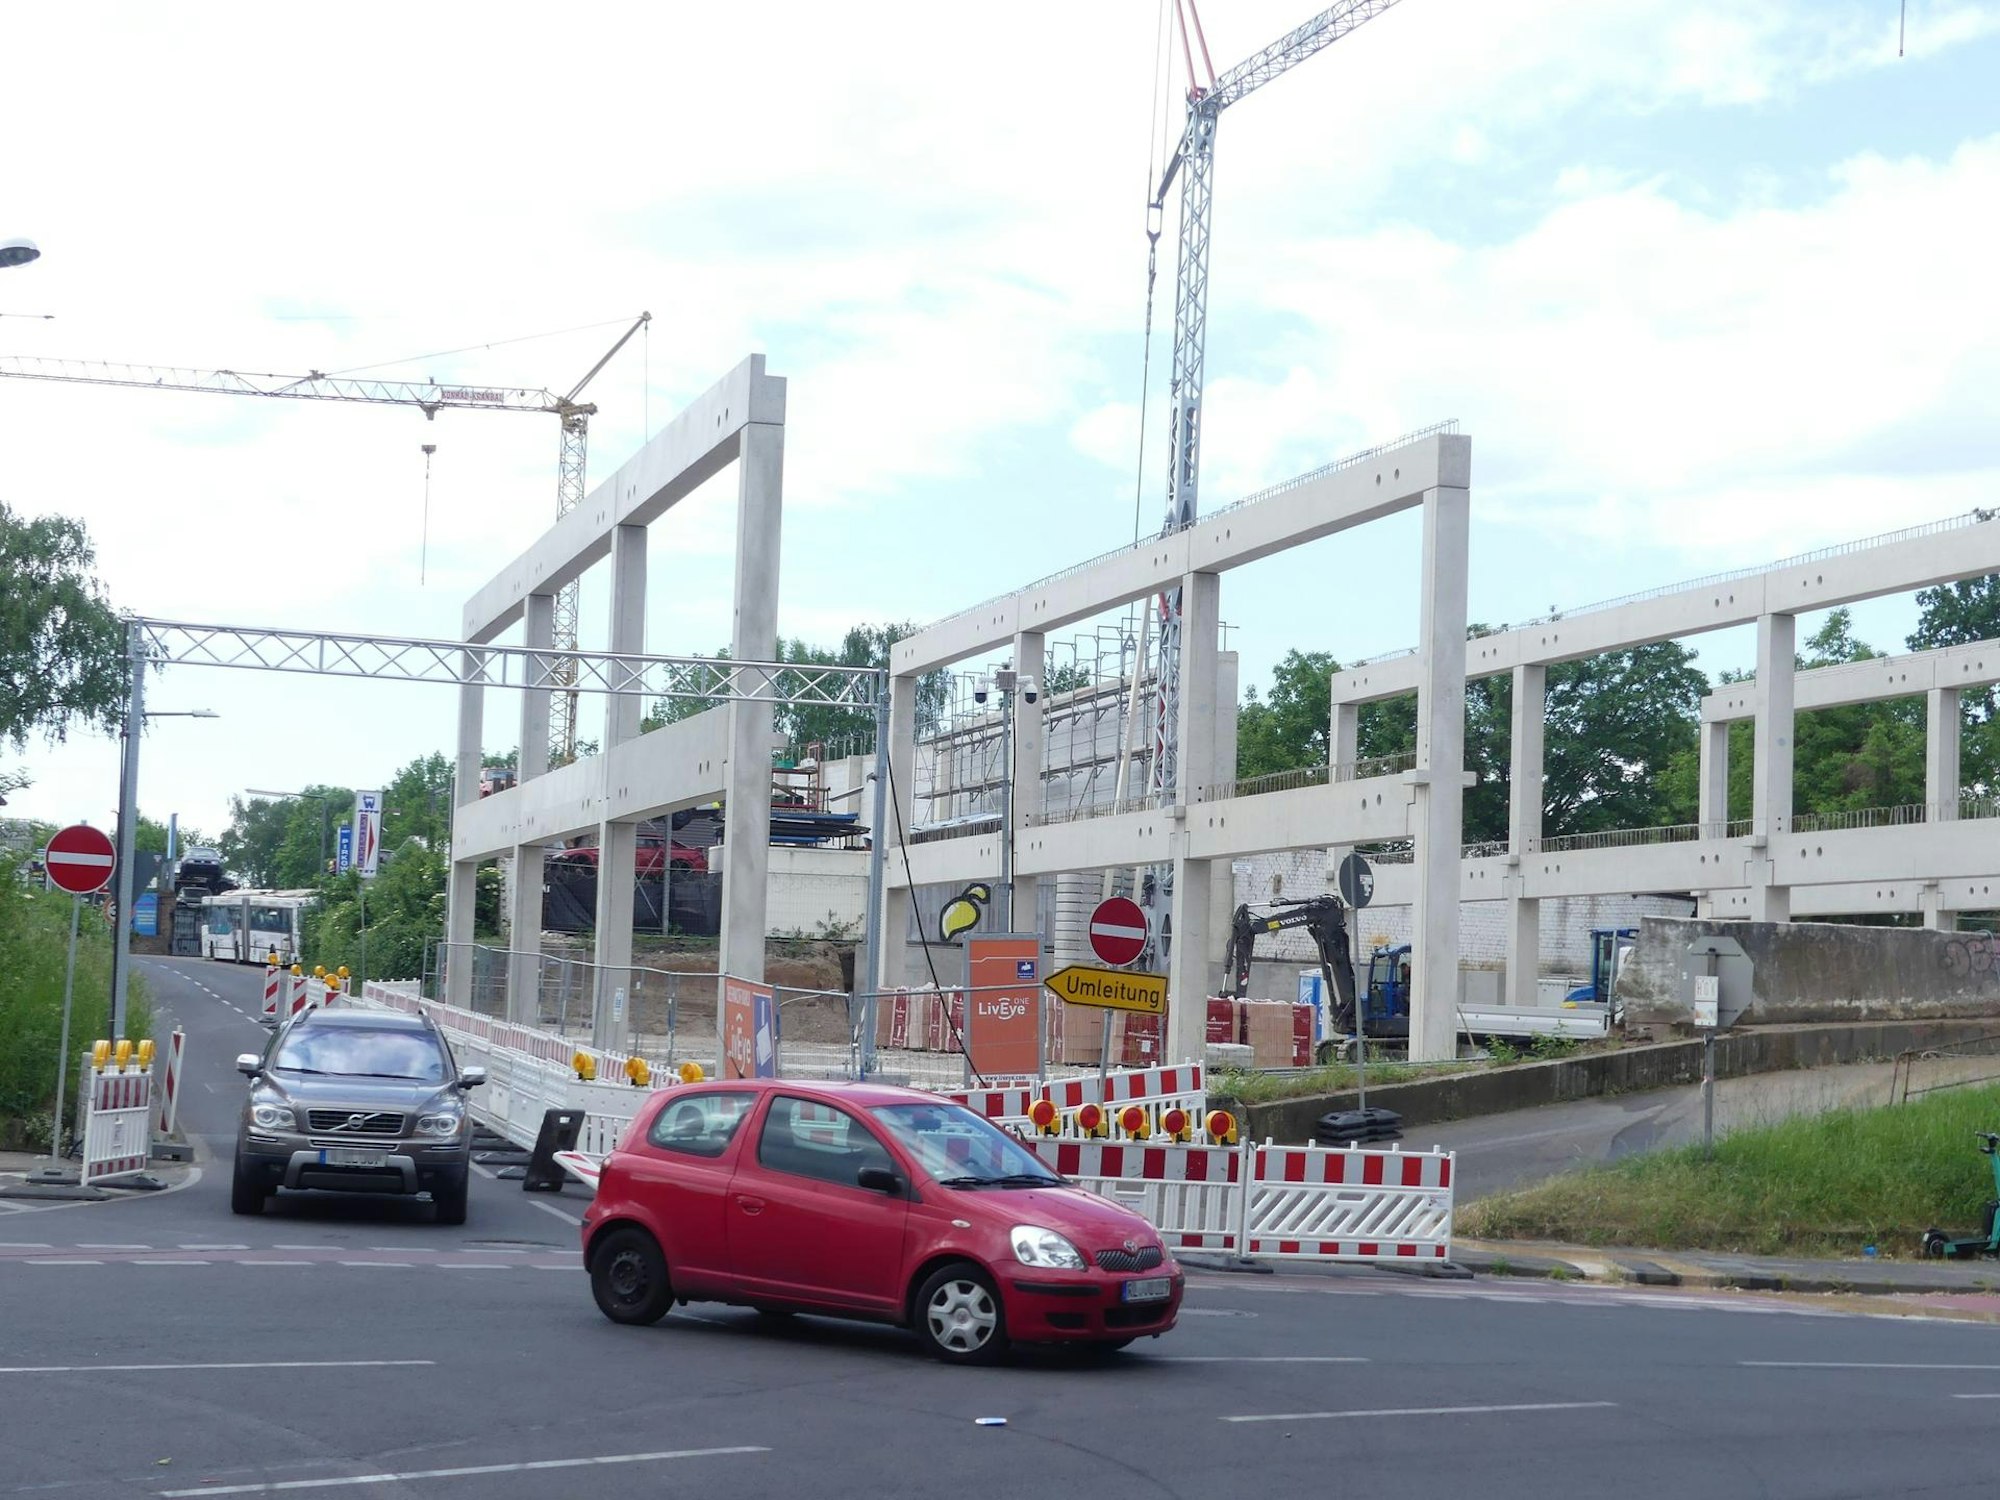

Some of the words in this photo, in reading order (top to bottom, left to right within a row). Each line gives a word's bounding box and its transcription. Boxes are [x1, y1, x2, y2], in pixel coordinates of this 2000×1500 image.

[1280, 915, 1307, 926] VOLVO
[1066, 975, 1160, 1009] Umleitung
[978, 998, 1026, 1019] LivEye
